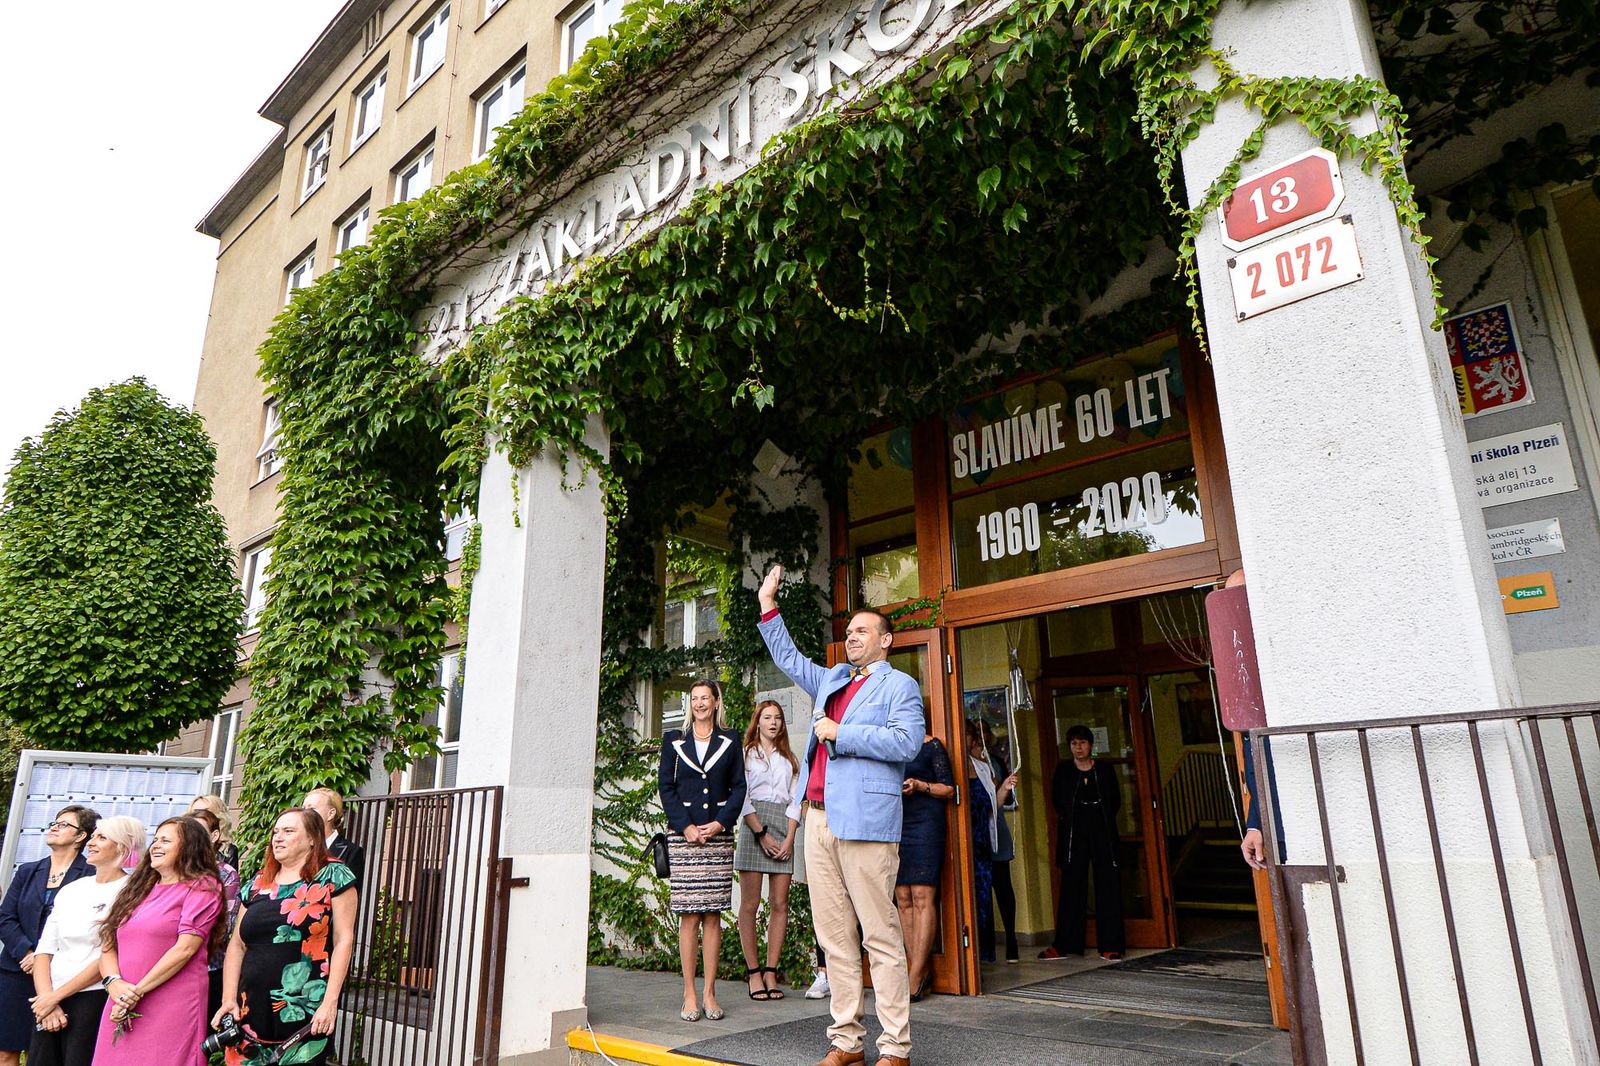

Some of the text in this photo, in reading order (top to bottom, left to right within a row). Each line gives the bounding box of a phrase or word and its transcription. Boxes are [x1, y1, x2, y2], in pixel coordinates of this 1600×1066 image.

[499, 68, 752, 303] ZÁKLADNÍ
[778, 0, 966, 119] ŠKO
[1249, 176, 1299, 224] 13
[953, 368, 1172, 479] SLAVÍME 60 LET
[1486, 445, 1520, 460] škola
[1522, 435, 1560, 452] Plzeň
[1495, 476, 1554, 494] organizace
[1498, 468, 1519, 480] alej
[1522, 465, 1537, 476] 13
[976, 502, 1041, 562] 1960
[1082, 472, 1167, 539] 2020
[1515, 546, 1533, 557] ČR
[1516, 586, 1543, 598] Plzeň
